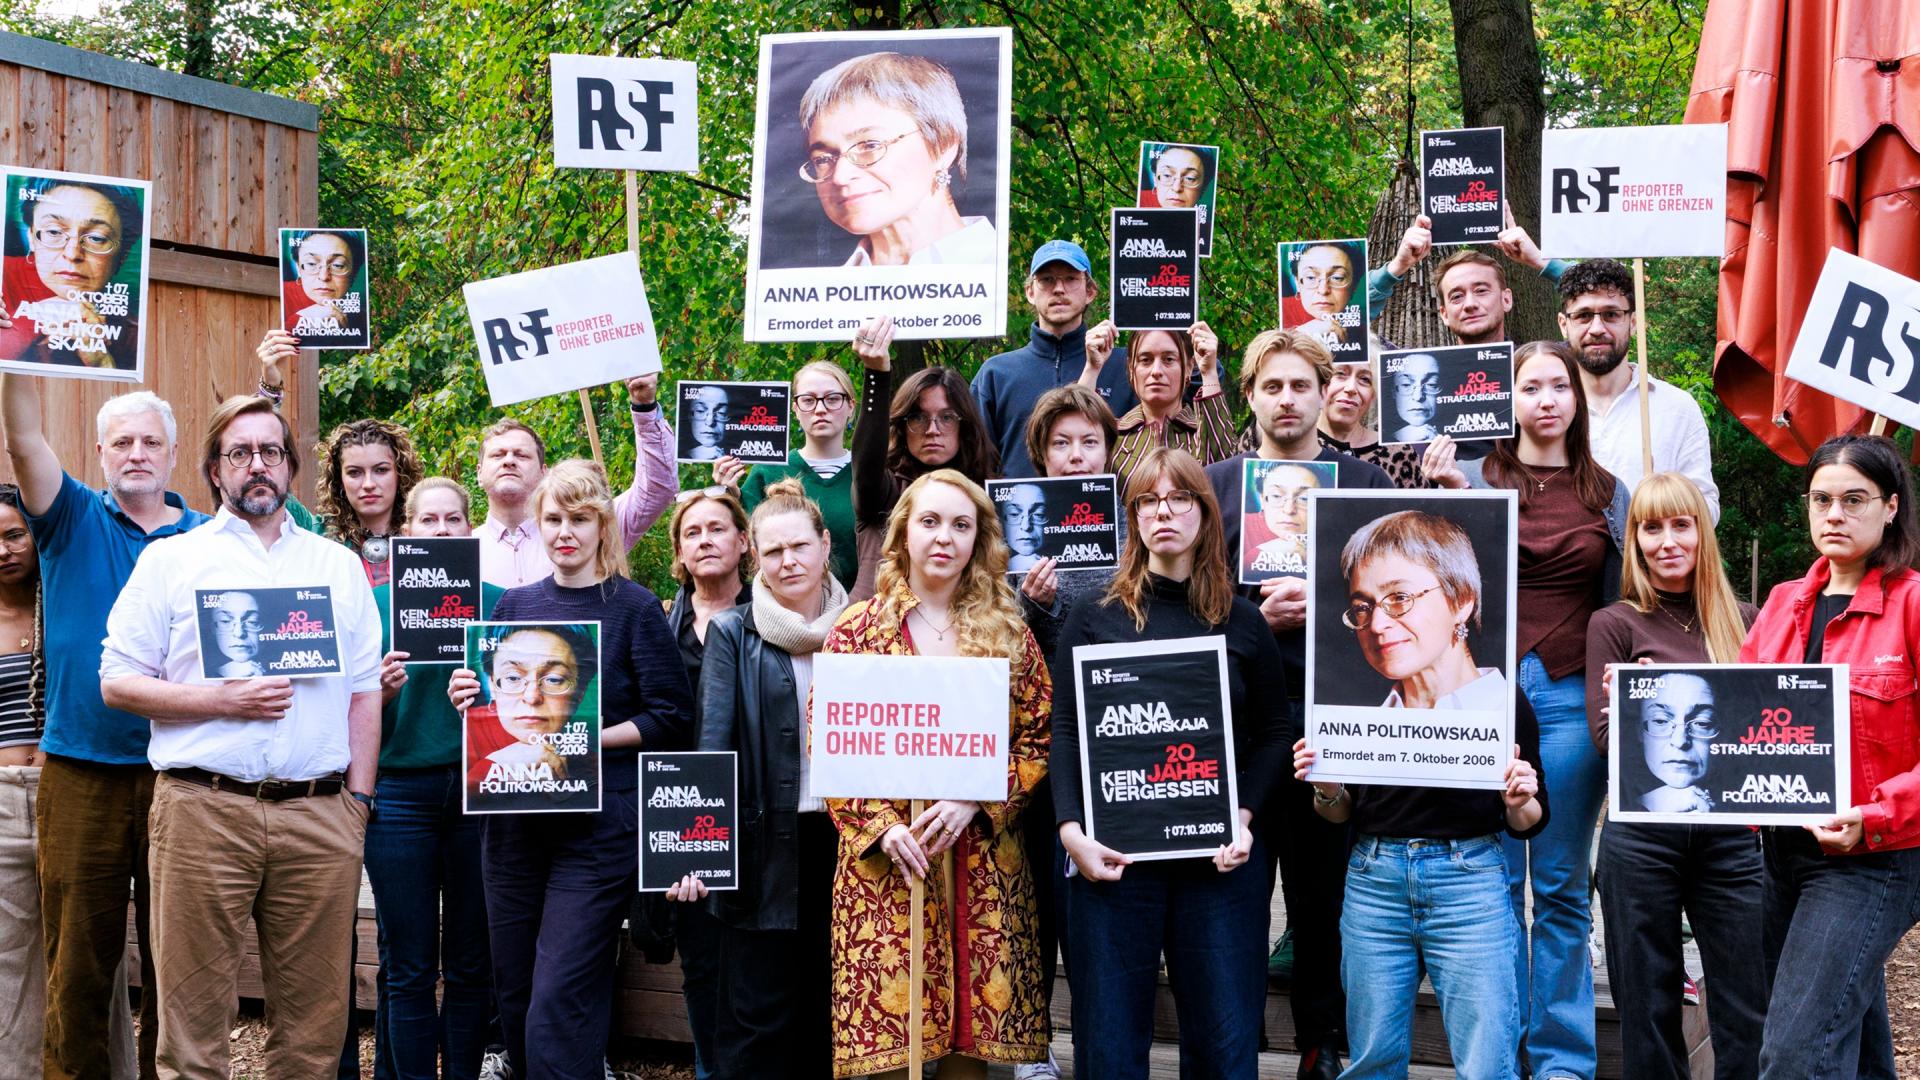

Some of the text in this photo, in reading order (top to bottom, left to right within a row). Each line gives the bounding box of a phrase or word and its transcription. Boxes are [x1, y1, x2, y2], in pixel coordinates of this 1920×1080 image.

[577, 77, 674, 152] RSF
[1432, 157, 1474, 170] ANNA
[1429, 166, 1494, 177] POLITKOWSKAJA
[1468, 180, 1486, 192] 20
[1552, 166, 1620, 214] RSF
[1622, 184, 1683, 197] REPORTER
[1430, 190, 1498, 204] KEIN JAHRE
[1430, 202, 1498, 214] VERGESSEN
[1622, 198, 1713, 212] OHNE GRENZEN
[1123, 238, 1165, 251] ANNA
[1119, 249, 1187, 258] POLITKOWSKAJA
[1160, 264, 1177, 276] 20
[1120, 275, 1190, 287] KEIN JAHRE
[66, 290, 129, 306] OKTOBER
[764, 283, 988, 303] ANNA POLITKOWSKAJA
[1120, 287, 1190, 297] VERGESSEN
[323, 299, 360, 307] OKTOBER
[13, 301, 83, 320] ANNA
[99, 304, 128, 317] 2006
[296, 317, 339, 329] ANNA
[556, 313, 614, 337] REPORTER
[768, 314, 982, 331] Ermordet am ktober 2006
[34, 320, 122, 340] POLITKOW
[292, 328, 361, 337] POLITKOWSKAJA
[559, 321, 645, 351] OHNE GRENZEN
[482, 308, 554, 366] RSF
[48, 336, 107, 353] SKAJA
[1467, 371, 1486, 384] 20
[1454, 382, 1500, 396] JAHRE
[1436, 392, 1511, 404] STRAFLOSIGKEIT
[752, 406, 768, 416] 20
[740, 416, 778, 425] JAHRE
[1455, 412, 1496, 426] ANNA
[725, 424, 786, 432] STRAFLOSIGKEIT
[1444, 422, 1509, 433] POLITKOWSKAJA
[740, 441, 773, 451] ANNA
[730, 449, 784, 457] POLITKOWSKAJA
[1073, 502, 1091, 514] 20
[1061, 513, 1104, 526] JAHRE
[1044, 523, 1114, 534] STRAFLOSIGKEIT
[1062, 543, 1101, 556] ANNA
[1255, 551, 1303, 565] ANNA
[401, 568, 448, 580] ANNA
[398, 579, 471, 588] POLITKOWSKAJA
[442, 594, 461, 607] 20
[288, 610, 308, 622] 20
[400, 606, 475, 619] KEIN JAHRE
[276, 621, 323, 633] JAHRE
[259, 631, 334, 641] STRAFLOSIGKEIT
[478, 638, 498, 651] RSF
[280, 650, 323, 662] ANNA
[270, 660, 336, 670] POLITKOWSKAJA
[1091, 668, 1112, 684] RSF
[1778, 675, 1799, 689] RSF
[1629, 688, 1658, 699] 2006
[827, 702, 941, 727] REPORTER
[1100, 701, 1172, 726] ANNA
[1761, 707, 1792, 727] 20
[1095, 717, 1209, 737] POLITKOWSKAJA
[1318, 722, 1500, 742] ANNA POLITKOWSKAJA
[528, 733, 588, 745] OKTOBER
[1740, 725, 1815, 745] JAHRE
[559, 744, 587, 755] 2006
[826, 731, 996, 757] OHNE GRENZEN
[1710, 743, 1832, 755] STRAFLOSIGKEIT
[1165, 743, 1196, 763] 20
[1322, 749, 1495, 766] Ermordet am 7. Oktober 2006
[485, 762, 553, 781] ANNA
[1100, 759, 1218, 787] KEIN JAHRE
[479, 780, 588, 794] POLITKOWSKAJA
[1740, 774, 1808, 793] ANNA
[651, 786, 701, 800] ANNA
[1102, 779, 1219, 803] VERGESSEN
[1722, 790, 1830, 804] POLITKOWSKAJA
[647, 798, 725, 808] POLITKOWSKAJA
[694, 815, 715, 828] 20
[649, 827, 730, 841] KEIN JAHRE
[649, 840, 729, 853] VERGESSEN
